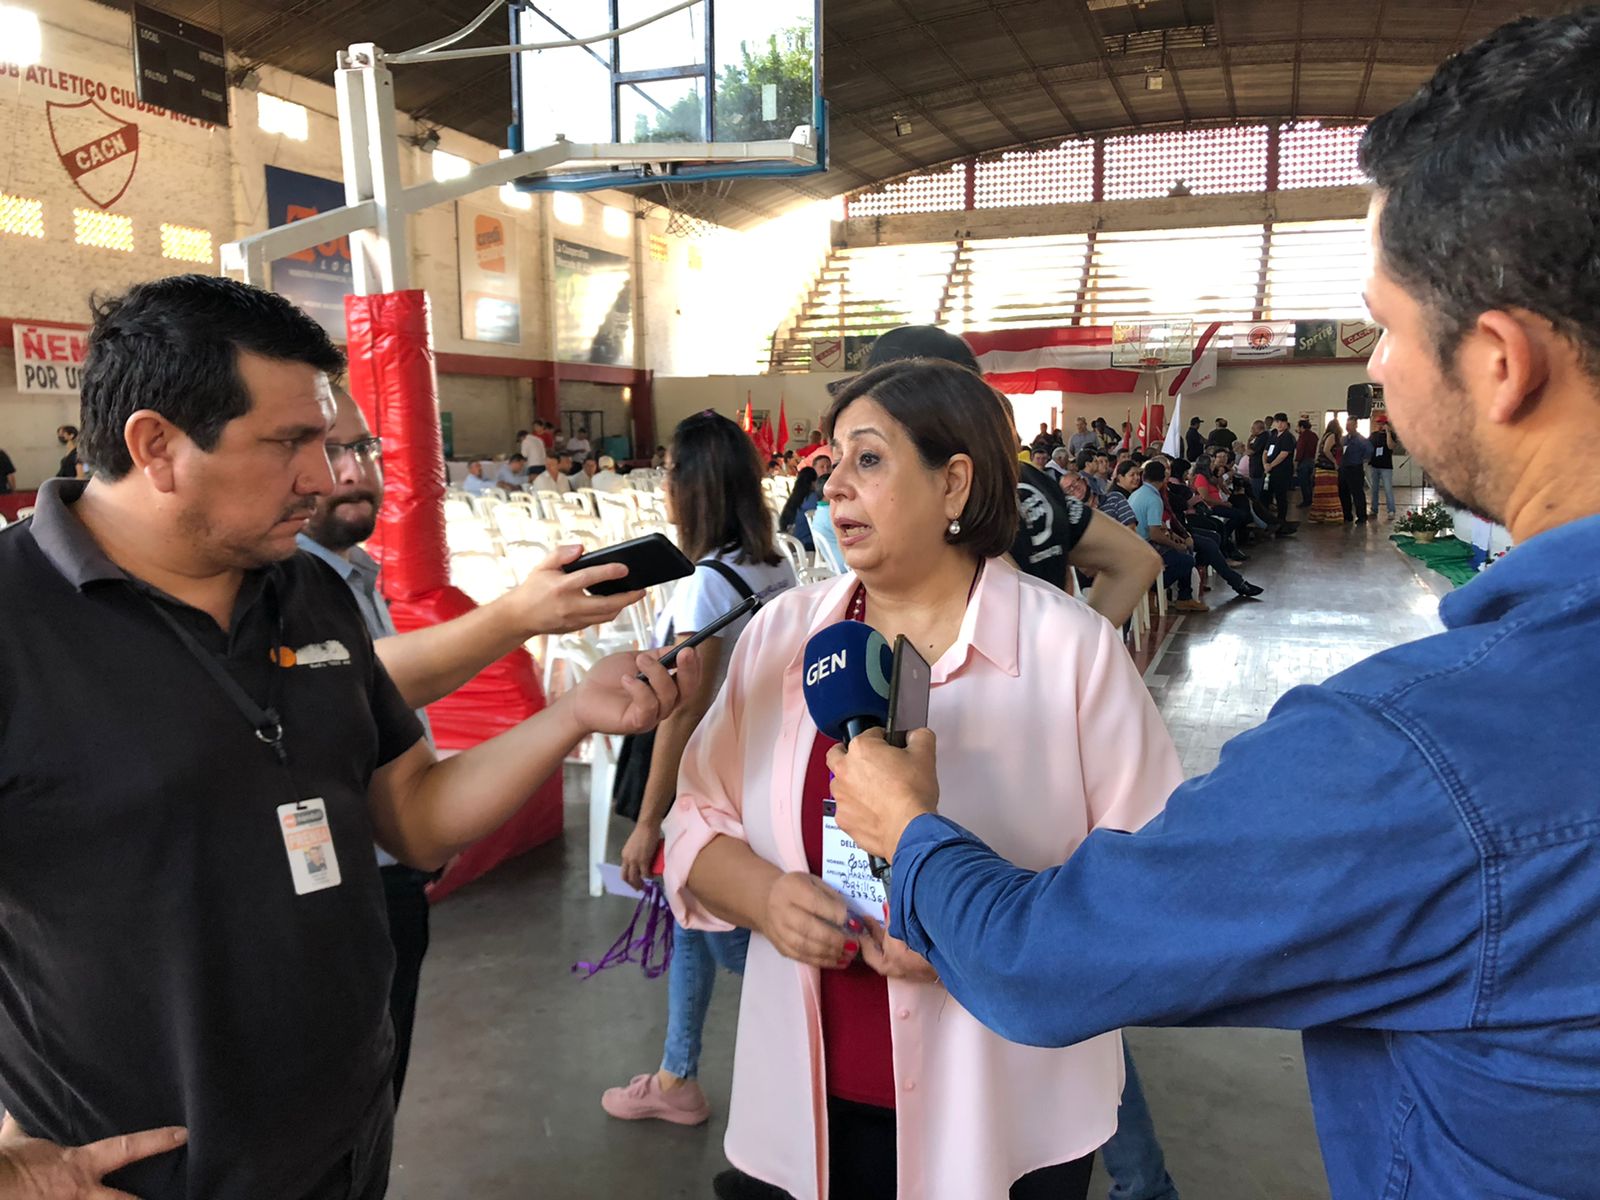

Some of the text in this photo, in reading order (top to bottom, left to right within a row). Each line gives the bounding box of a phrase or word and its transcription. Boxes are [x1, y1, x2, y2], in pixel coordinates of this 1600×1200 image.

[26, 65, 107, 101] ATLETICO
[75, 133, 127, 169] CACN
[1300, 325, 1333, 351] Sprite
[24, 364, 60, 389] POR
[806, 649, 847, 687] GEN
